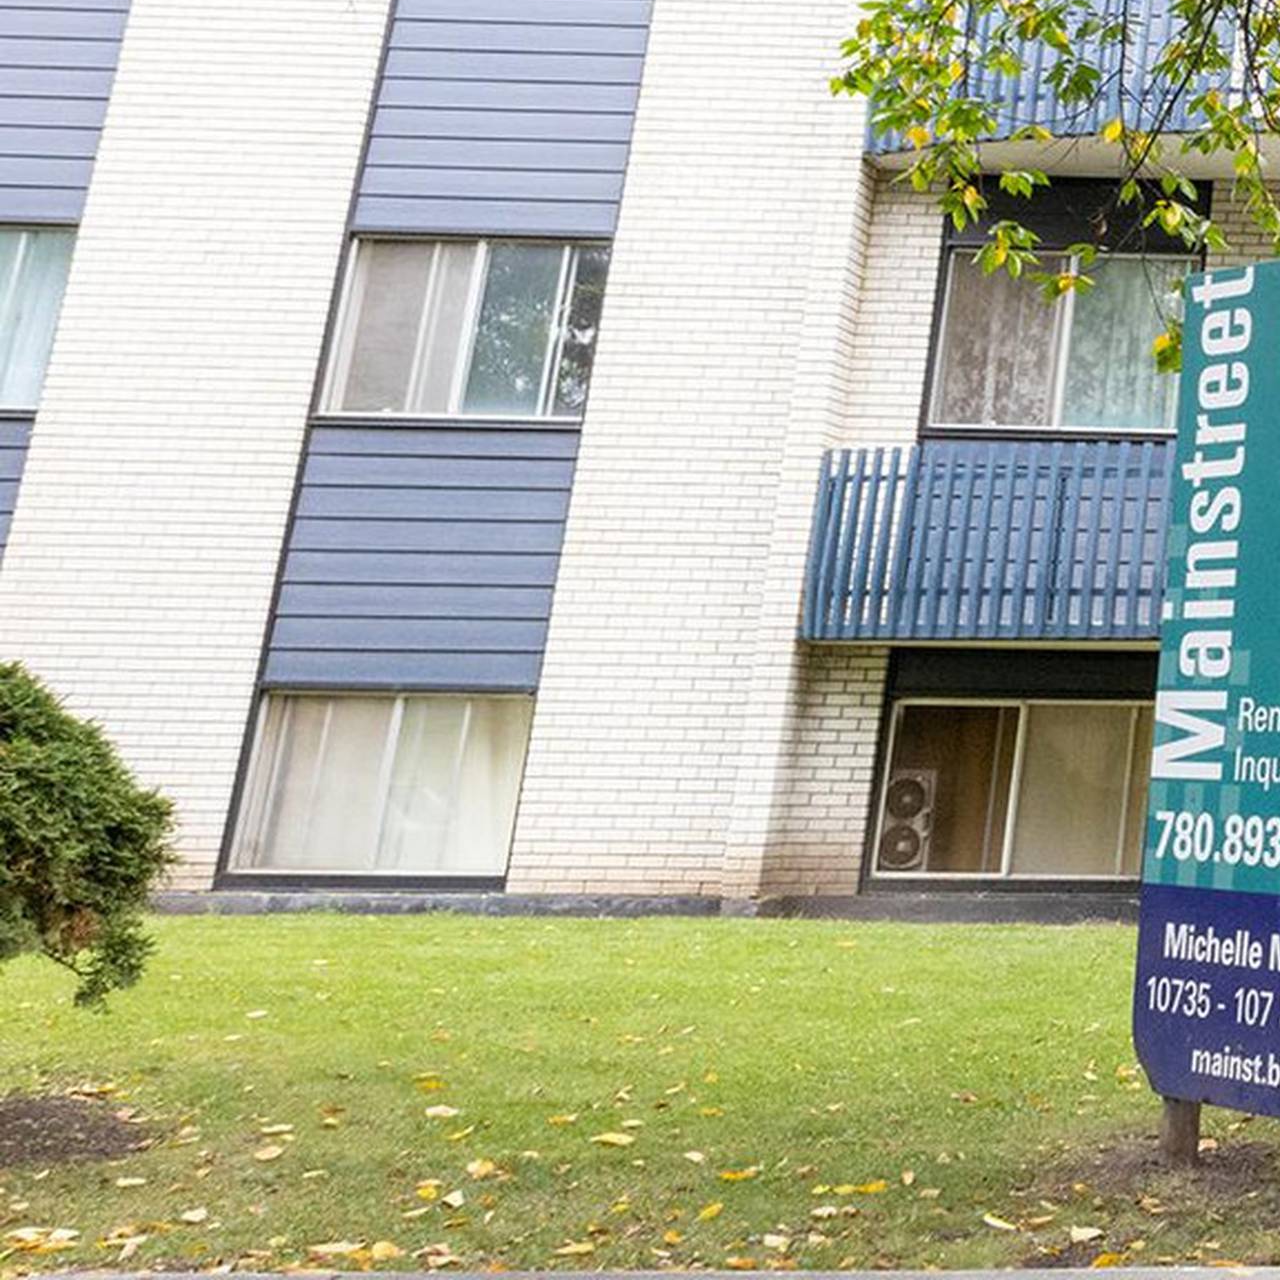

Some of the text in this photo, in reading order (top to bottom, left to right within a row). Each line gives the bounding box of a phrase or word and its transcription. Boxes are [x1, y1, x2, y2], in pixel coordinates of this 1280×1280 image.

[1149, 265, 1256, 782] Mainstreet
[1163, 922, 1260, 970] Michelle
[1146, 976, 1211, 1018] 10735
[1234, 988, 1274, 1027] 107
